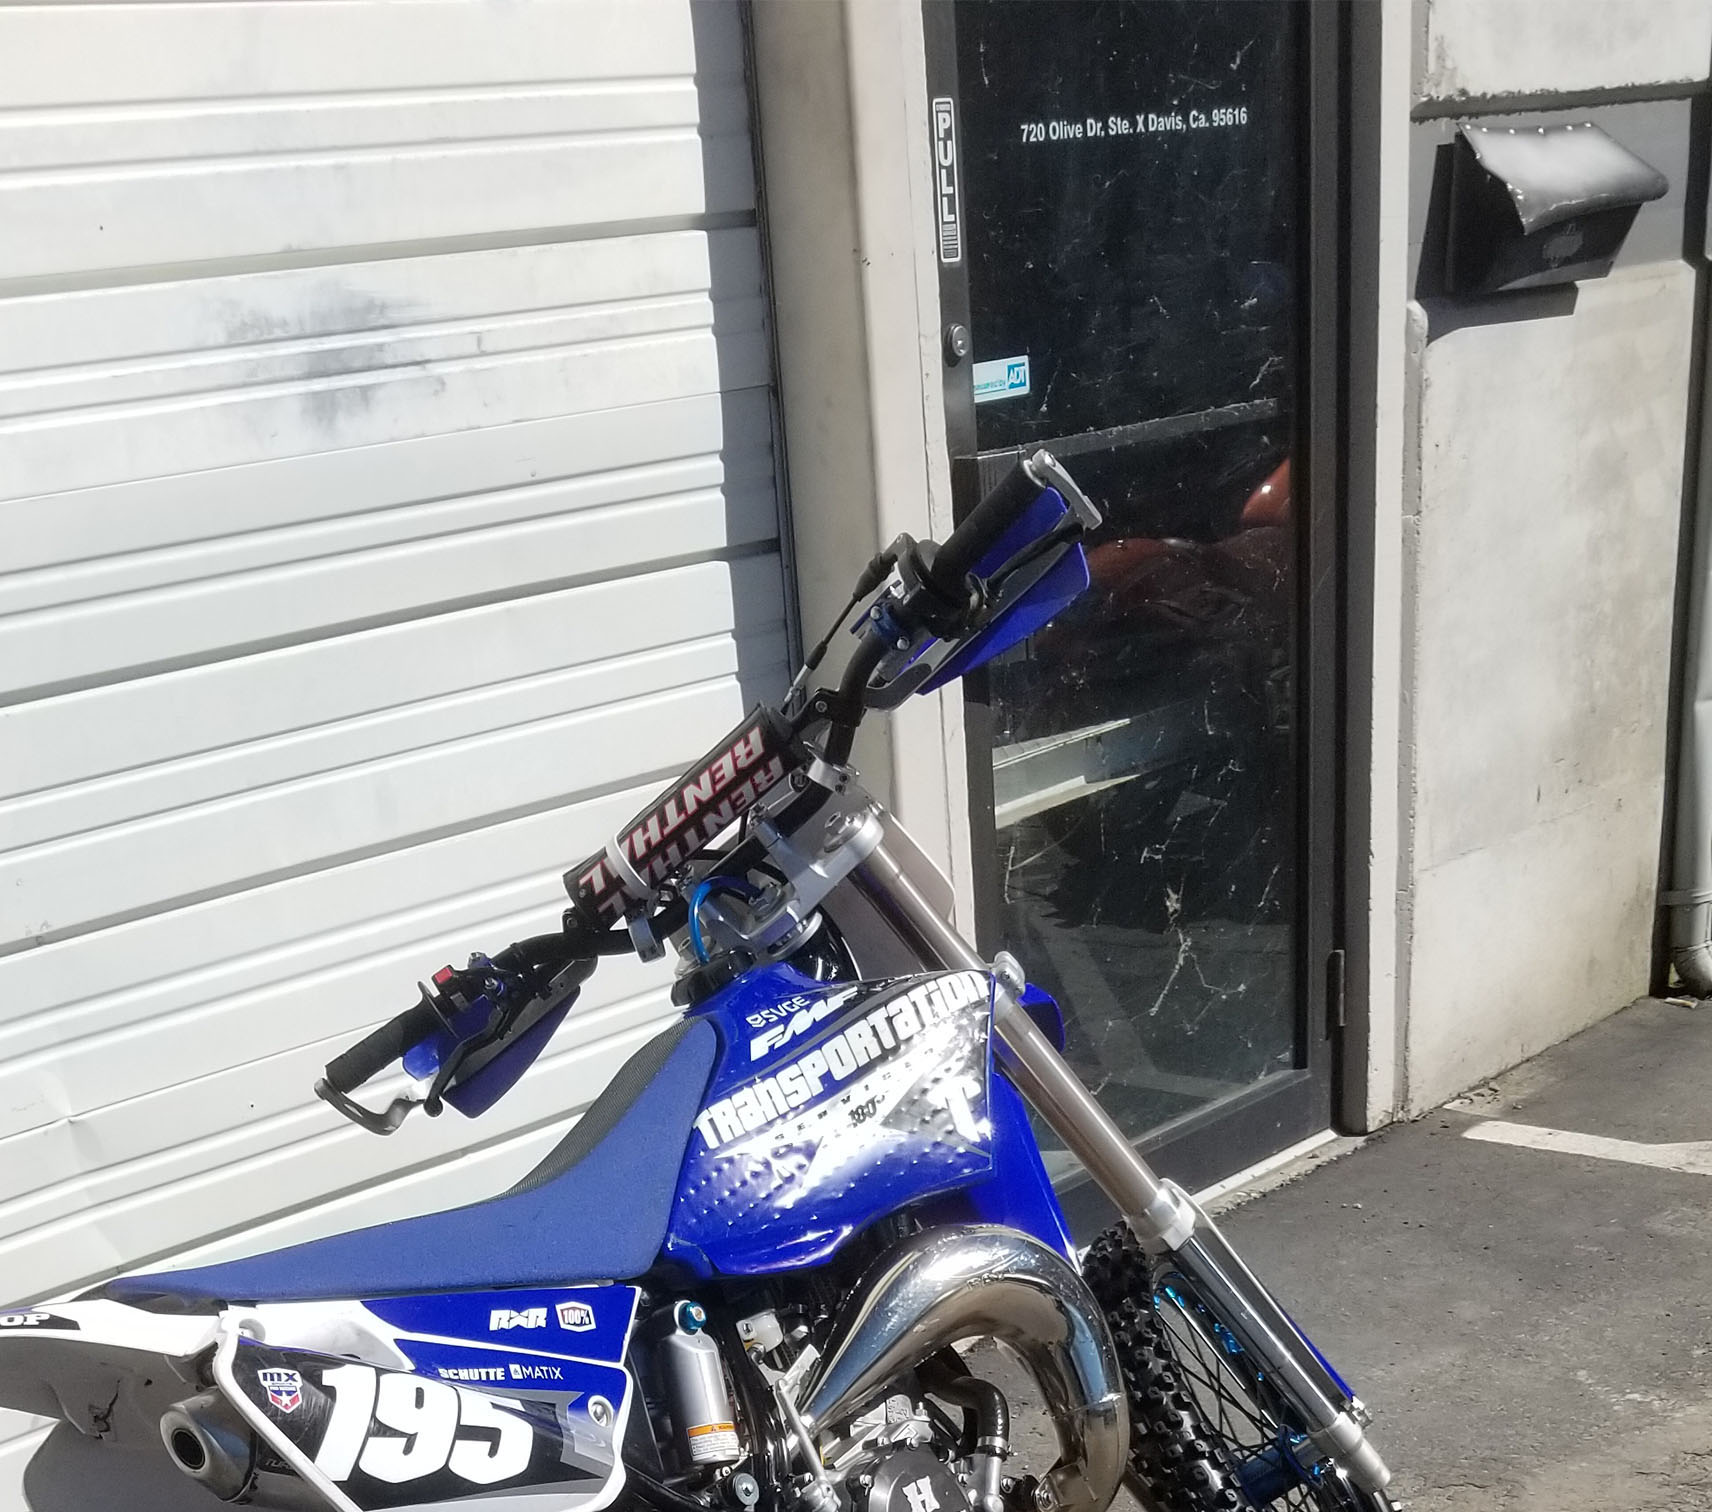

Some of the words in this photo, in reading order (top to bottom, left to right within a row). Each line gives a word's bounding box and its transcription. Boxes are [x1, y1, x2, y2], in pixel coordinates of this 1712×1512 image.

[1020, 123, 1046, 142] 720
[1049, 120, 1084, 140] Olive
[1086, 118, 1105, 137] Dr.
[1108, 116, 1133, 136] Ste.
[1136, 114, 1146, 133] X
[1148, 111, 1187, 132] Davis,
[1189, 109, 1210, 129] Ca.
[1212, 107, 1248, 127] 95616
[937, 112, 956, 222] PULL
[1008, 365, 1026, 384] ADT
[562, 1308, 592, 1325] 100%
[438, 1367, 506, 1381] SCHUTTE
[522, 1365, 564, 1380] MATIX
[314, 1363, 534, 1485] 195
